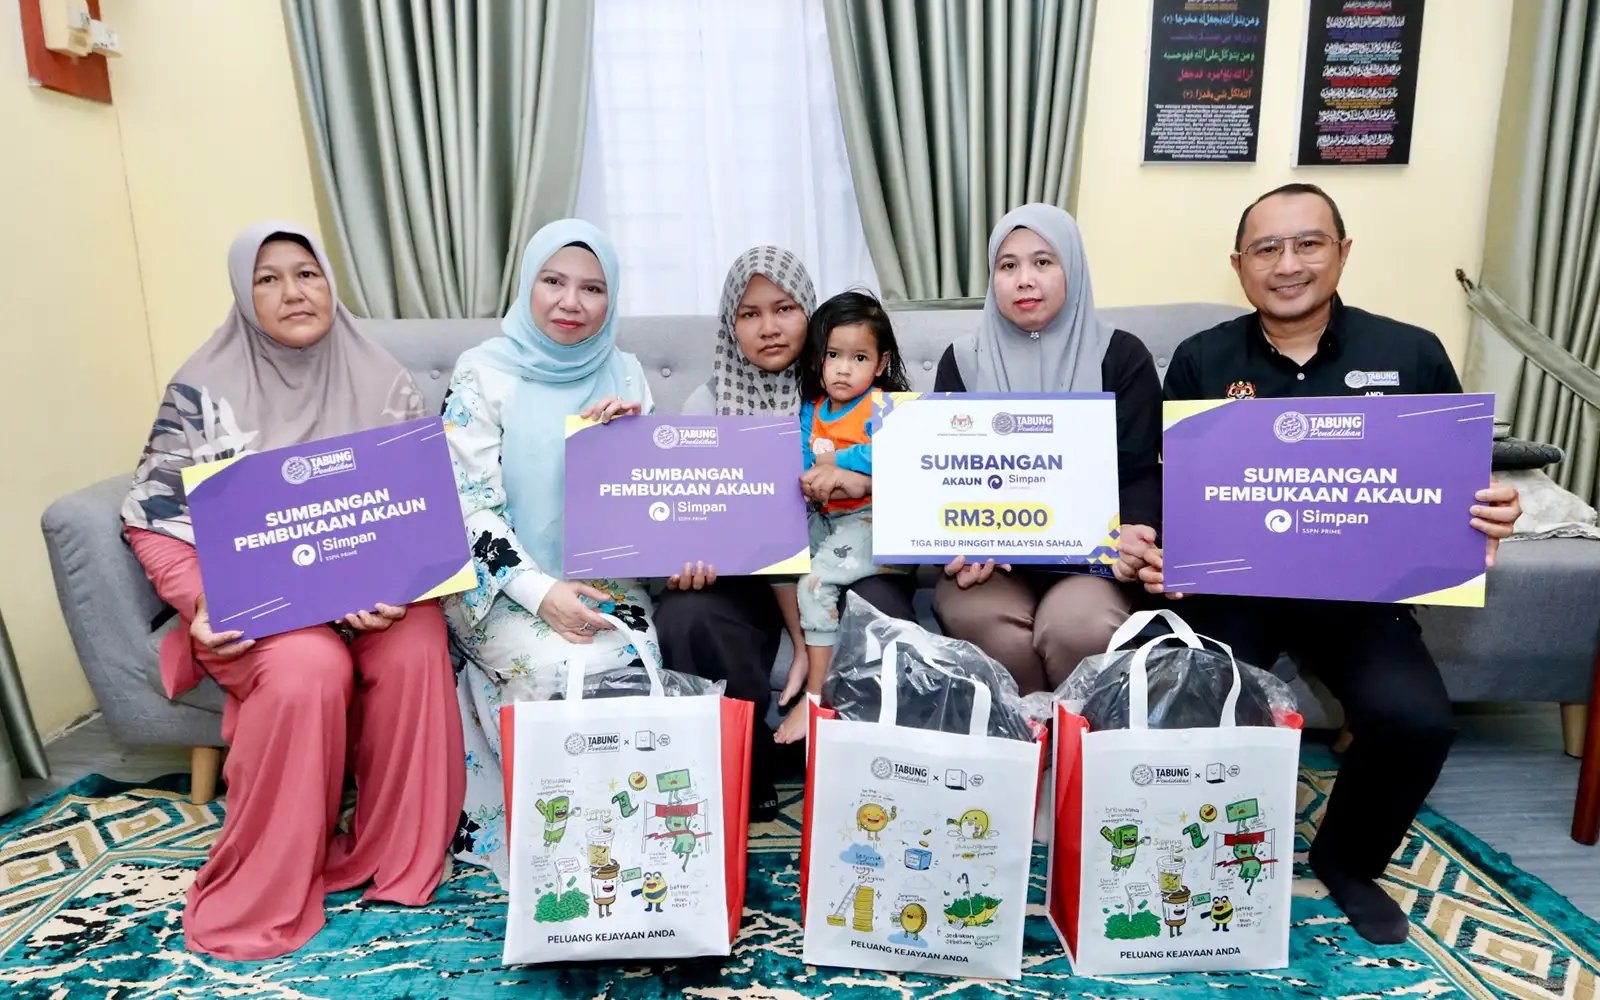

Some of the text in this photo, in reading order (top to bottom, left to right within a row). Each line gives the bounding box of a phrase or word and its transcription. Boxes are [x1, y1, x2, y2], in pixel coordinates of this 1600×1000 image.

[1016, 416, 1052, 425] TABUNG
[1310, 416, 1362, 428] TABUNG
[680, 430, 716, 438] TABUNG
[1310, 428, 1362, 438] Pendidikan
[310, 451, 352, 468] TABUNG
[920, 454, 1063, 470] SUMBANGAN
[632, 468, 744, 480] SUMBANGAN
[942, 474, 1046, 486] AKAUN Simpan
[1244, 468, 1397, 484] SUMBANGAN
[600, 483, 774, 496] PEMBUKAAN AKAUN
[1205, 486, 1442, 504] PEMBUKAAN AKAUN
[265, 488, 390, 527] SUMBANGAN
[678, 502, 726, 514] Simpan
[944, 508, 1048, 530] RM3,000
[1302, 510, 1368, 526] Simpan
[234, 498, 426, 552] PEMBUKAAN AKAUN
[322, 532, 376, 551] Simpan
[958, 540, 994, 548] RINGGIT
[998, 540, 1044, 548] MALAYSIA
[1046, 540, 1082, 548] SAHAJA
[588, 735, 618, 744] TABUNG
[894, 764, 927, 776] TABUNG
[1156, 768, 1189, 776] TABUNG
[548, 930, 676, 944] PELUANG KEJAYAAN ANDA
[851, 940, 968, 962] PELUANG KEJAYAAN ANDA
[1166, 949, 1213, 958] KEJAYAAN
[1216, 947, 1240, 956] ANDA
